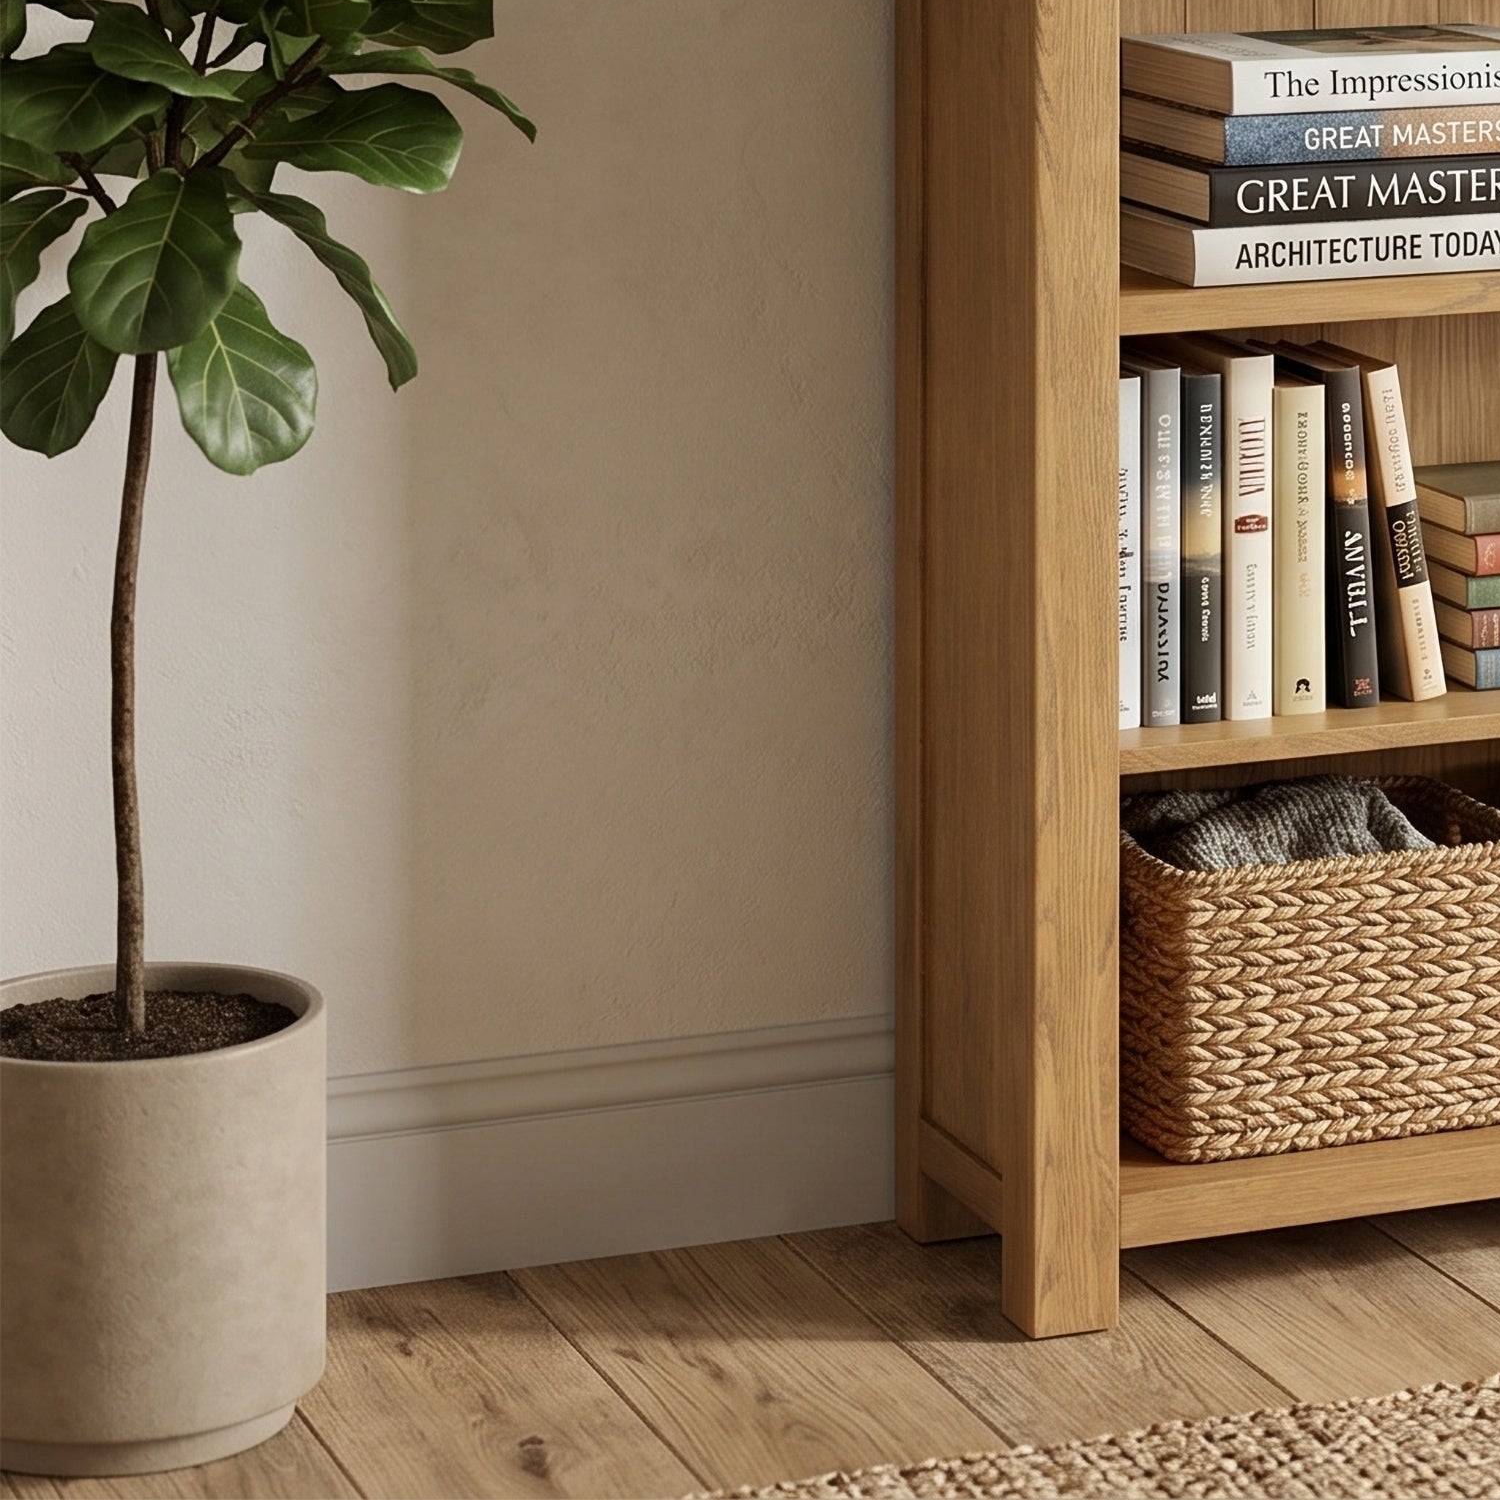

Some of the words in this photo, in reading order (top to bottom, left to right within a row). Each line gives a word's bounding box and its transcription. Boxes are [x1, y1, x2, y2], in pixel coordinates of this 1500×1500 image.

[1264, 70, 1320, 98] The
[1304, 126, 1385, 151] GREAT
[1236, 176, 1355, 215] GREAT
[1235, 235, 1422, 270] ARCHITECTURE
